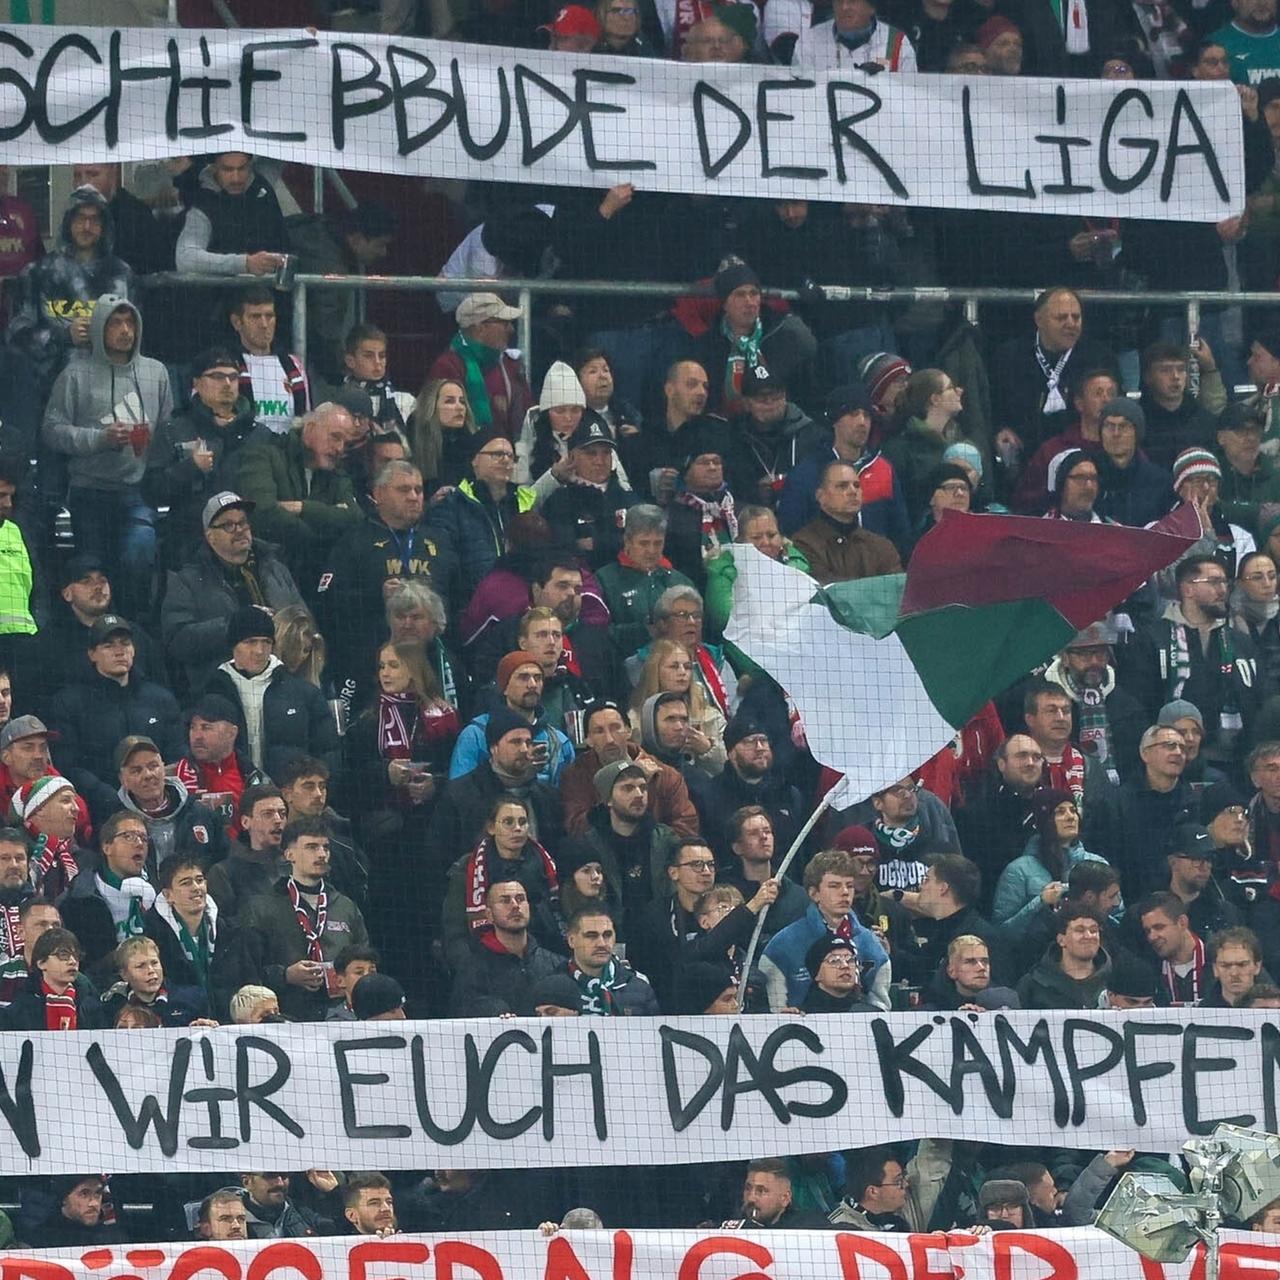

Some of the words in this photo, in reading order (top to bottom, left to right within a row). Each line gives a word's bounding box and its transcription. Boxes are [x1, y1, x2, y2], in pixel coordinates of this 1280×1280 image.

[694, 77, 909, 199] DER
[87, 1037, 306, 1158] WIR
[334, 1028, 608, 1145] EUCH
[660, 1023, 849, 1133] DAS
